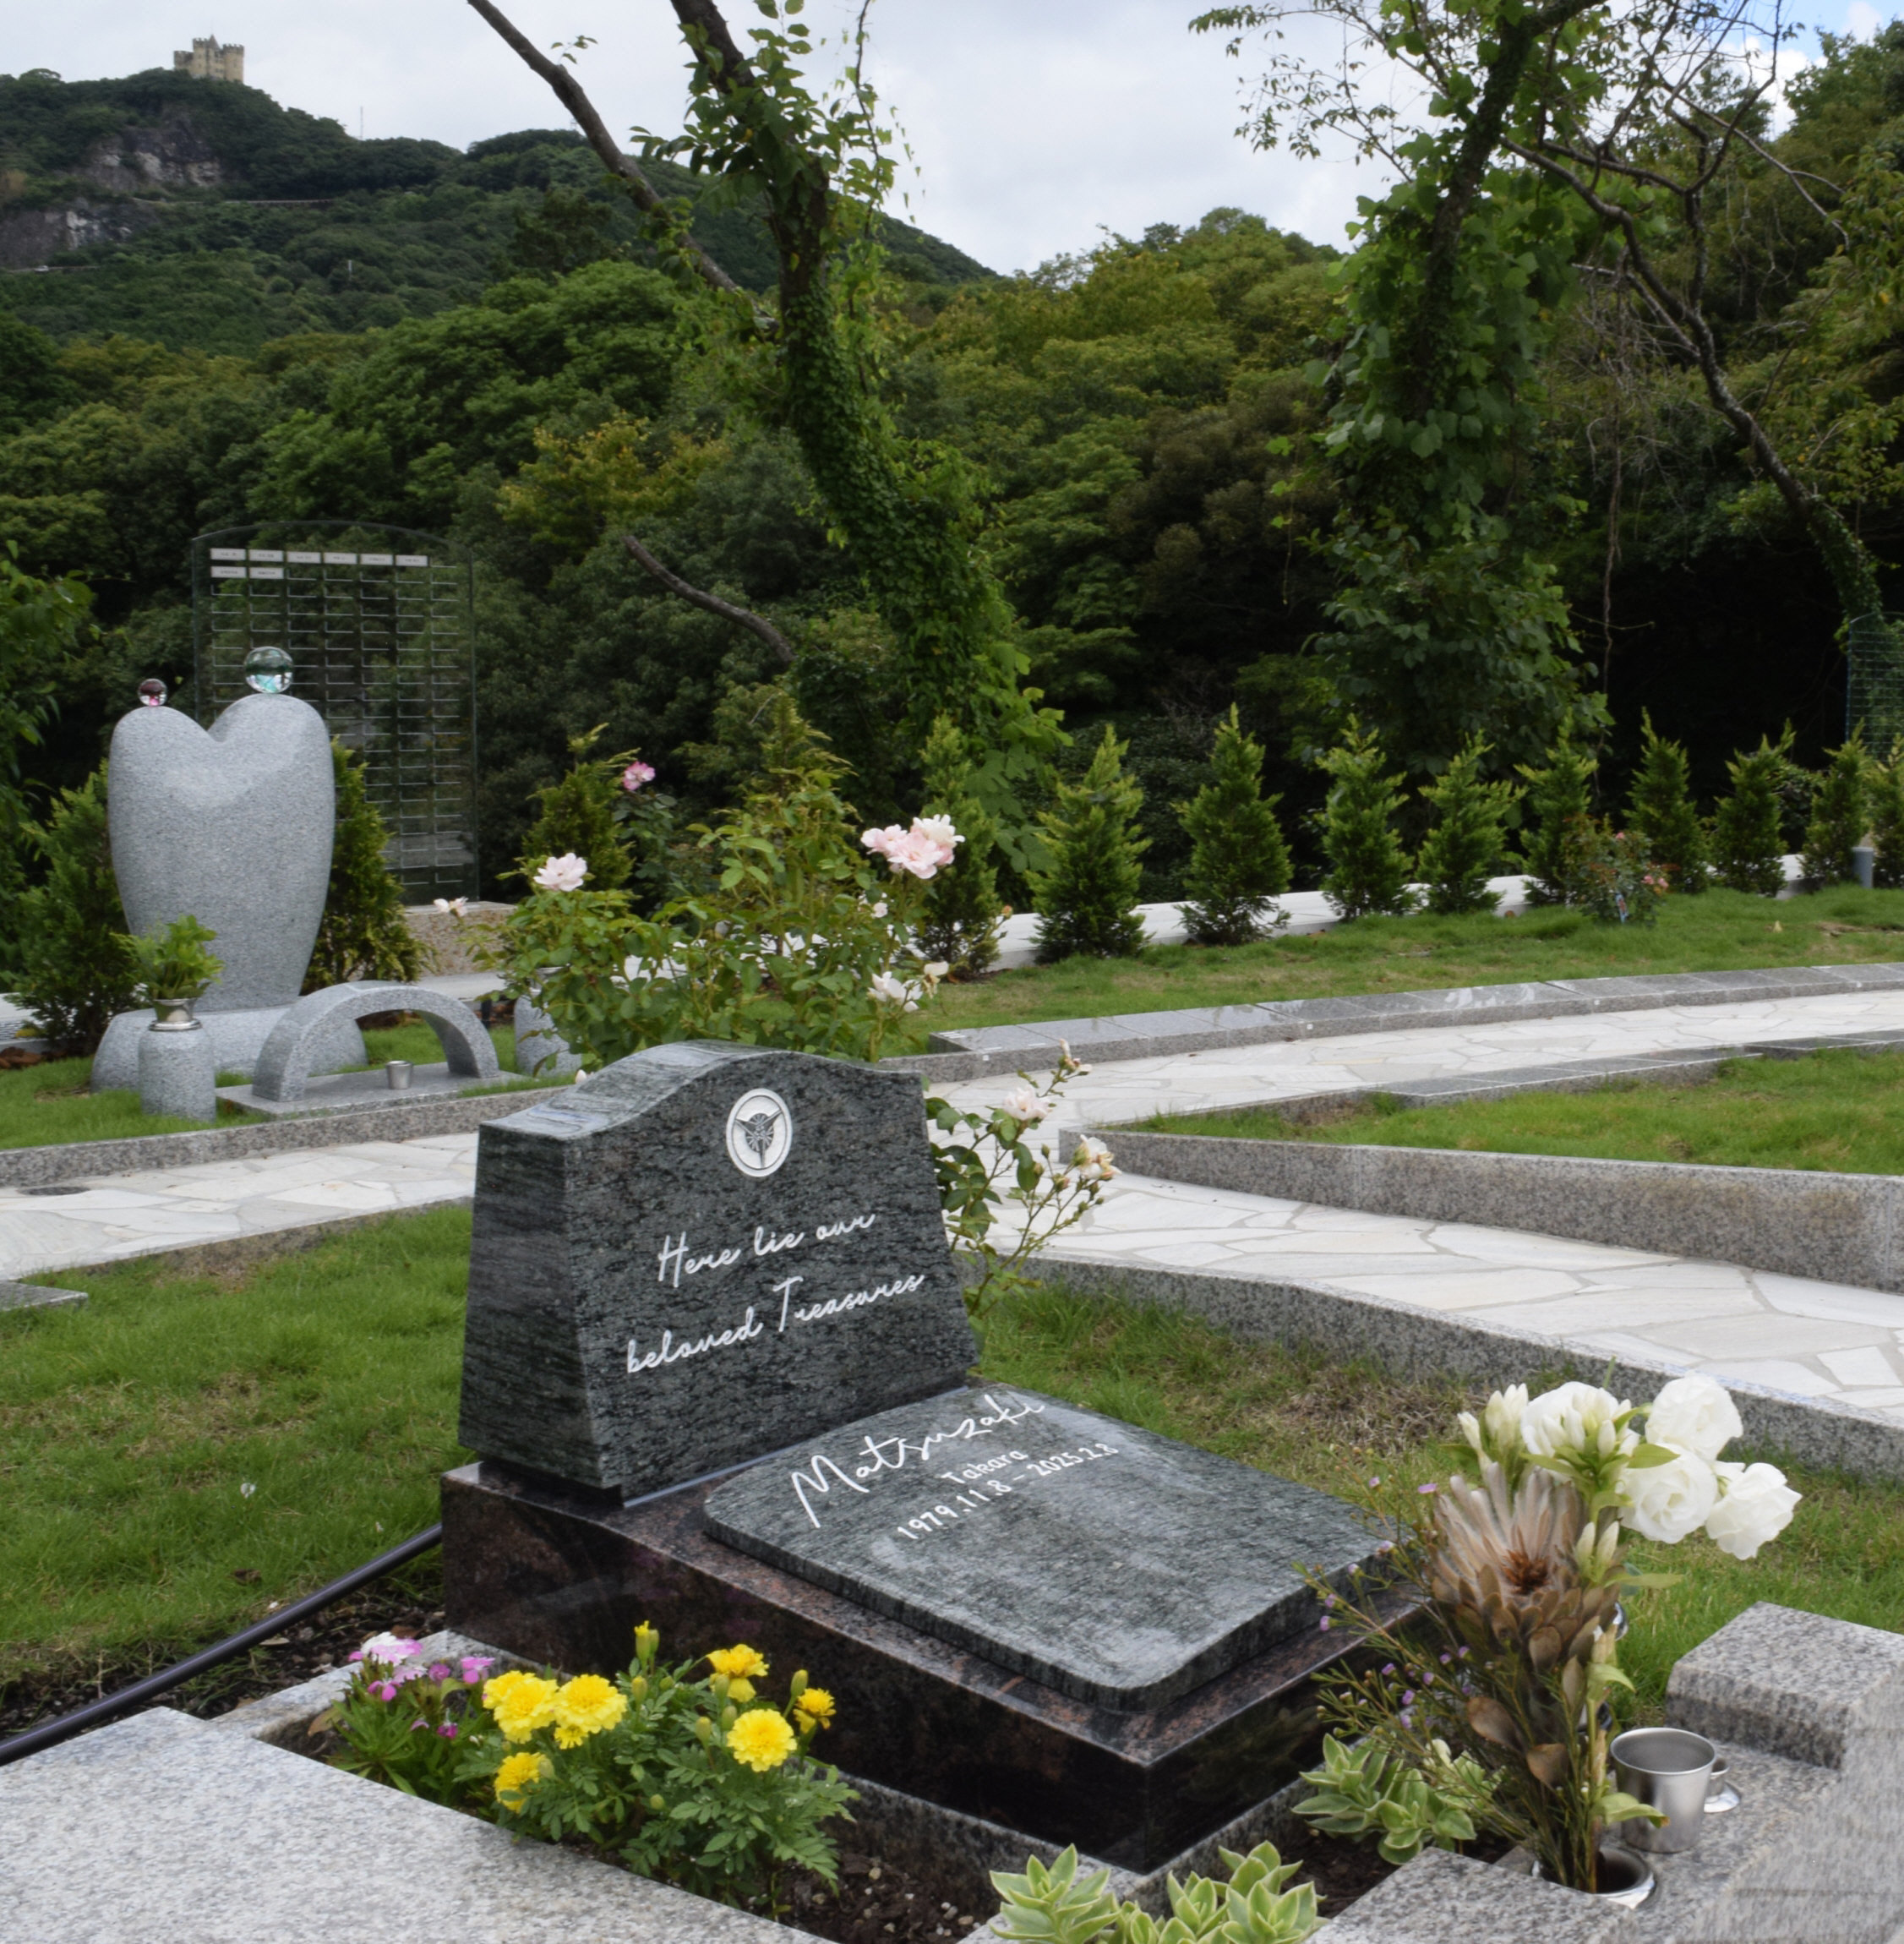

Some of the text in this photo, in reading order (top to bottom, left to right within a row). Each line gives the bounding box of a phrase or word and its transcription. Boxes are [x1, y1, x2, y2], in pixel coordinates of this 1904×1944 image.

[658, 1213, 876, 1287] Here lie our
[626, 1275, 925, 1373] beloved Treasures
[791, 1394, 1045, 1529] Matsuzaki
[897, 1479, 1012, 1540] 1979.11.8
[1027, 1443, 1120, 1477] 2025.2.8
[941, 1449, 1028, 1485] Takara
